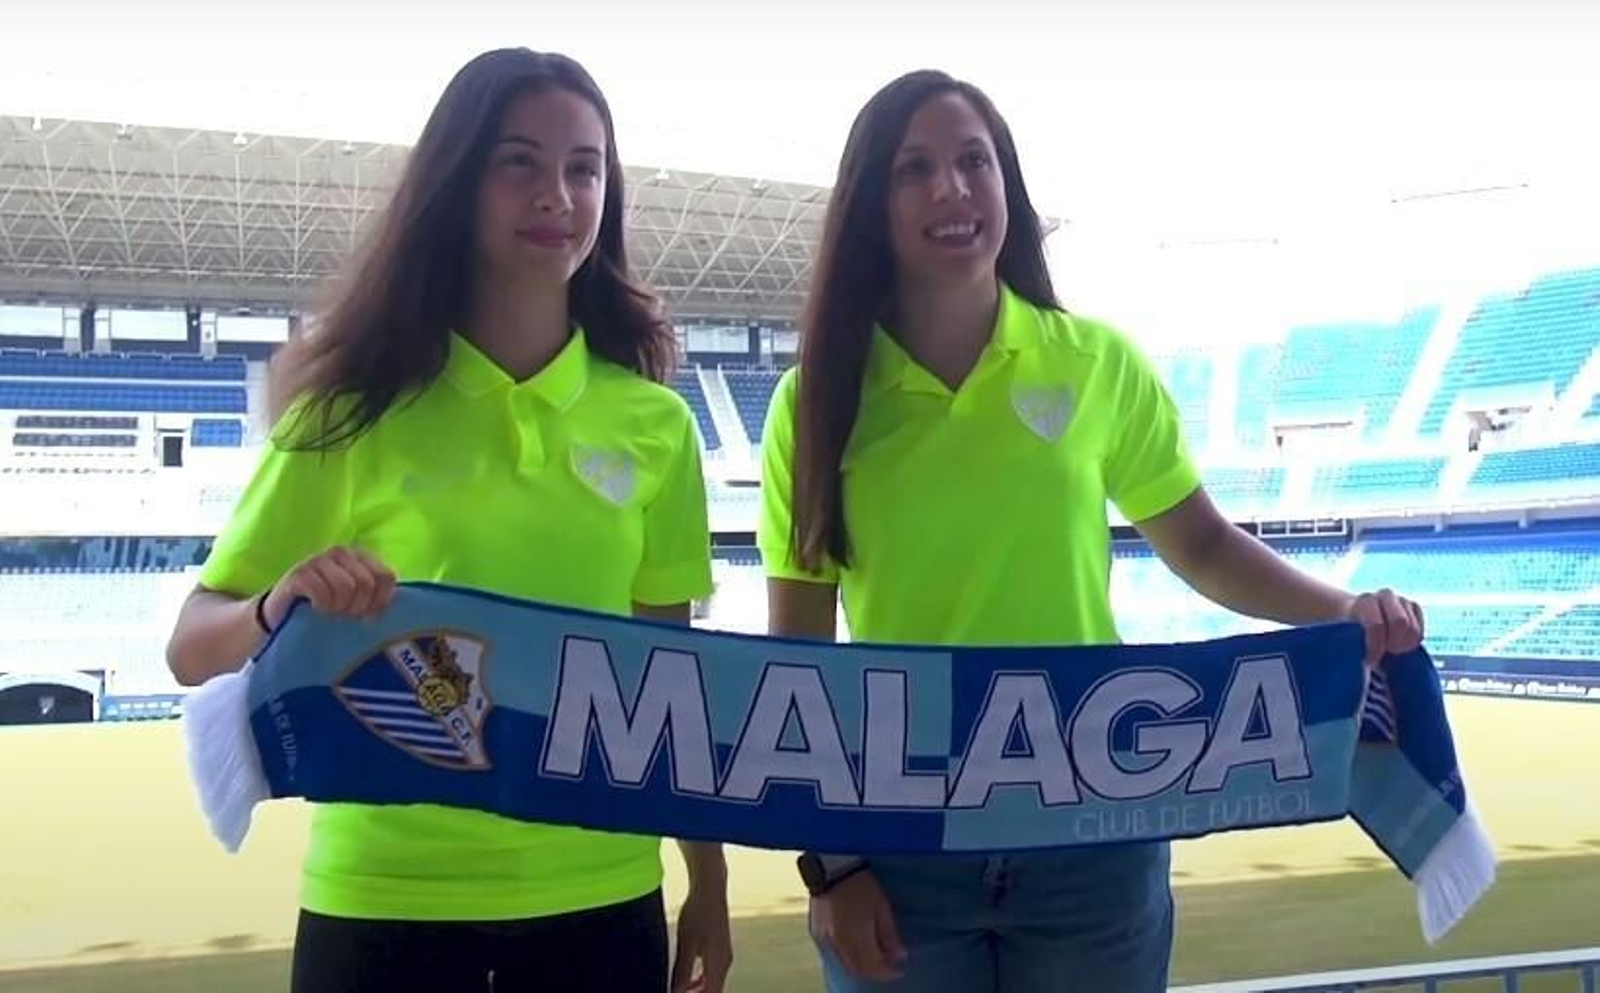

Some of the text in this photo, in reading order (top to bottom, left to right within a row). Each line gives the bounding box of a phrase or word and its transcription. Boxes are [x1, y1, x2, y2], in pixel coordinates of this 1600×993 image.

[538, 634, 1311, 809] MALAGA
[1075, 789, 1313, 841] CLUB DE FUTBOL
